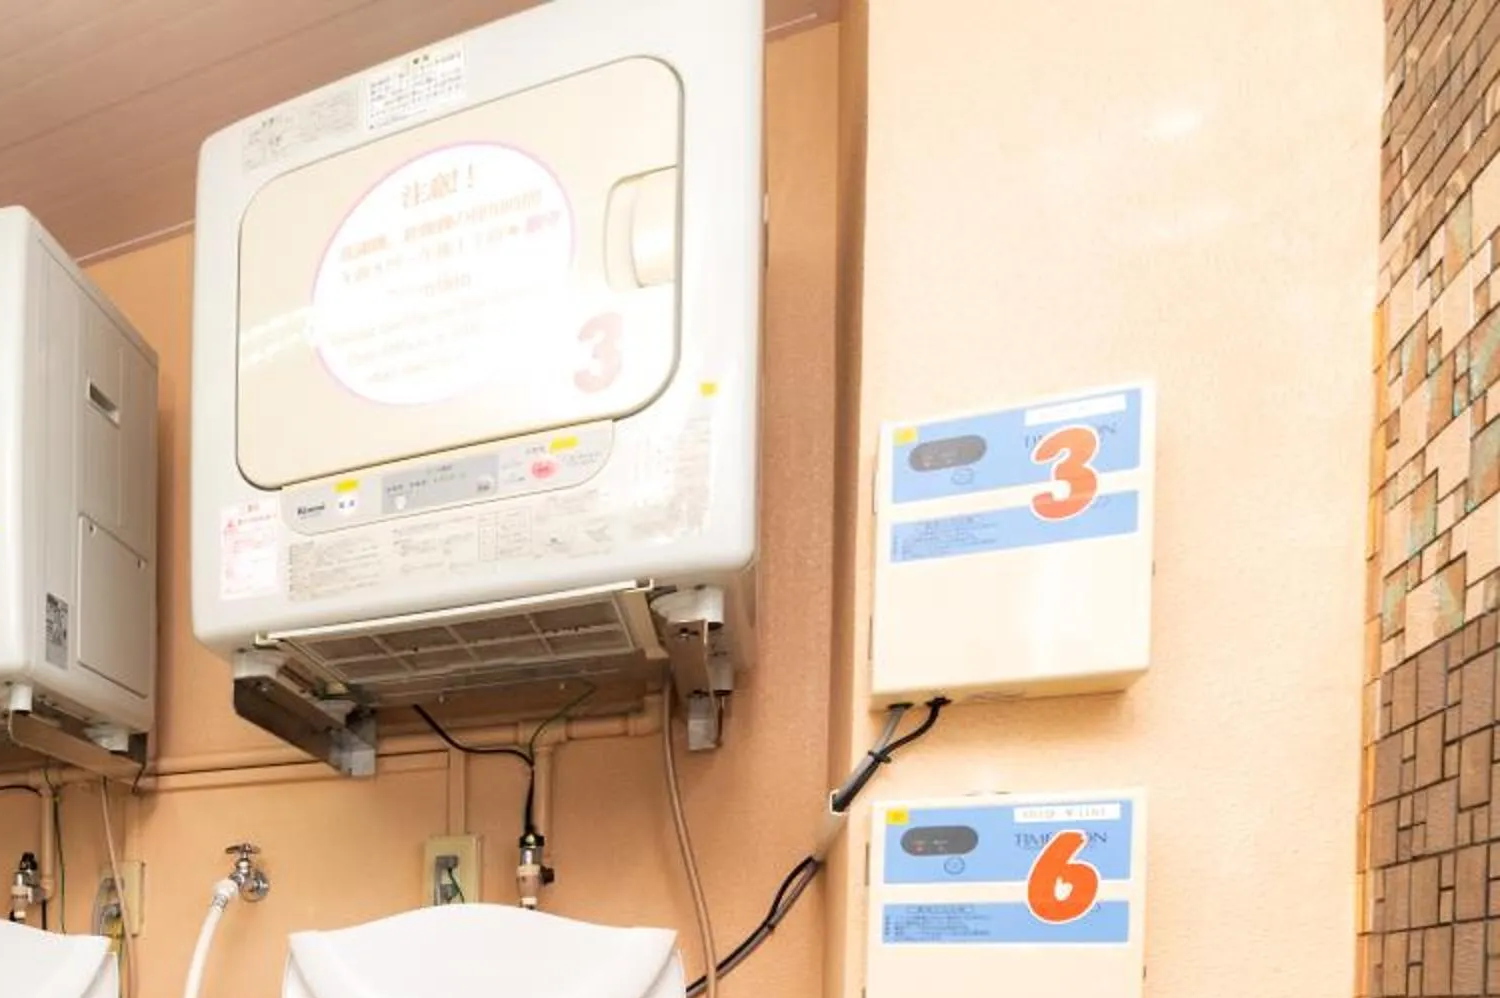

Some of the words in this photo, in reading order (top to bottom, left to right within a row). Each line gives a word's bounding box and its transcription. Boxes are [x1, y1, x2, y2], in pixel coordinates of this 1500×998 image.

[573, 311, 624, 395] 3
[1033, 427, 1098, 519] 3
[1027, 831, 1100, 923] 6
